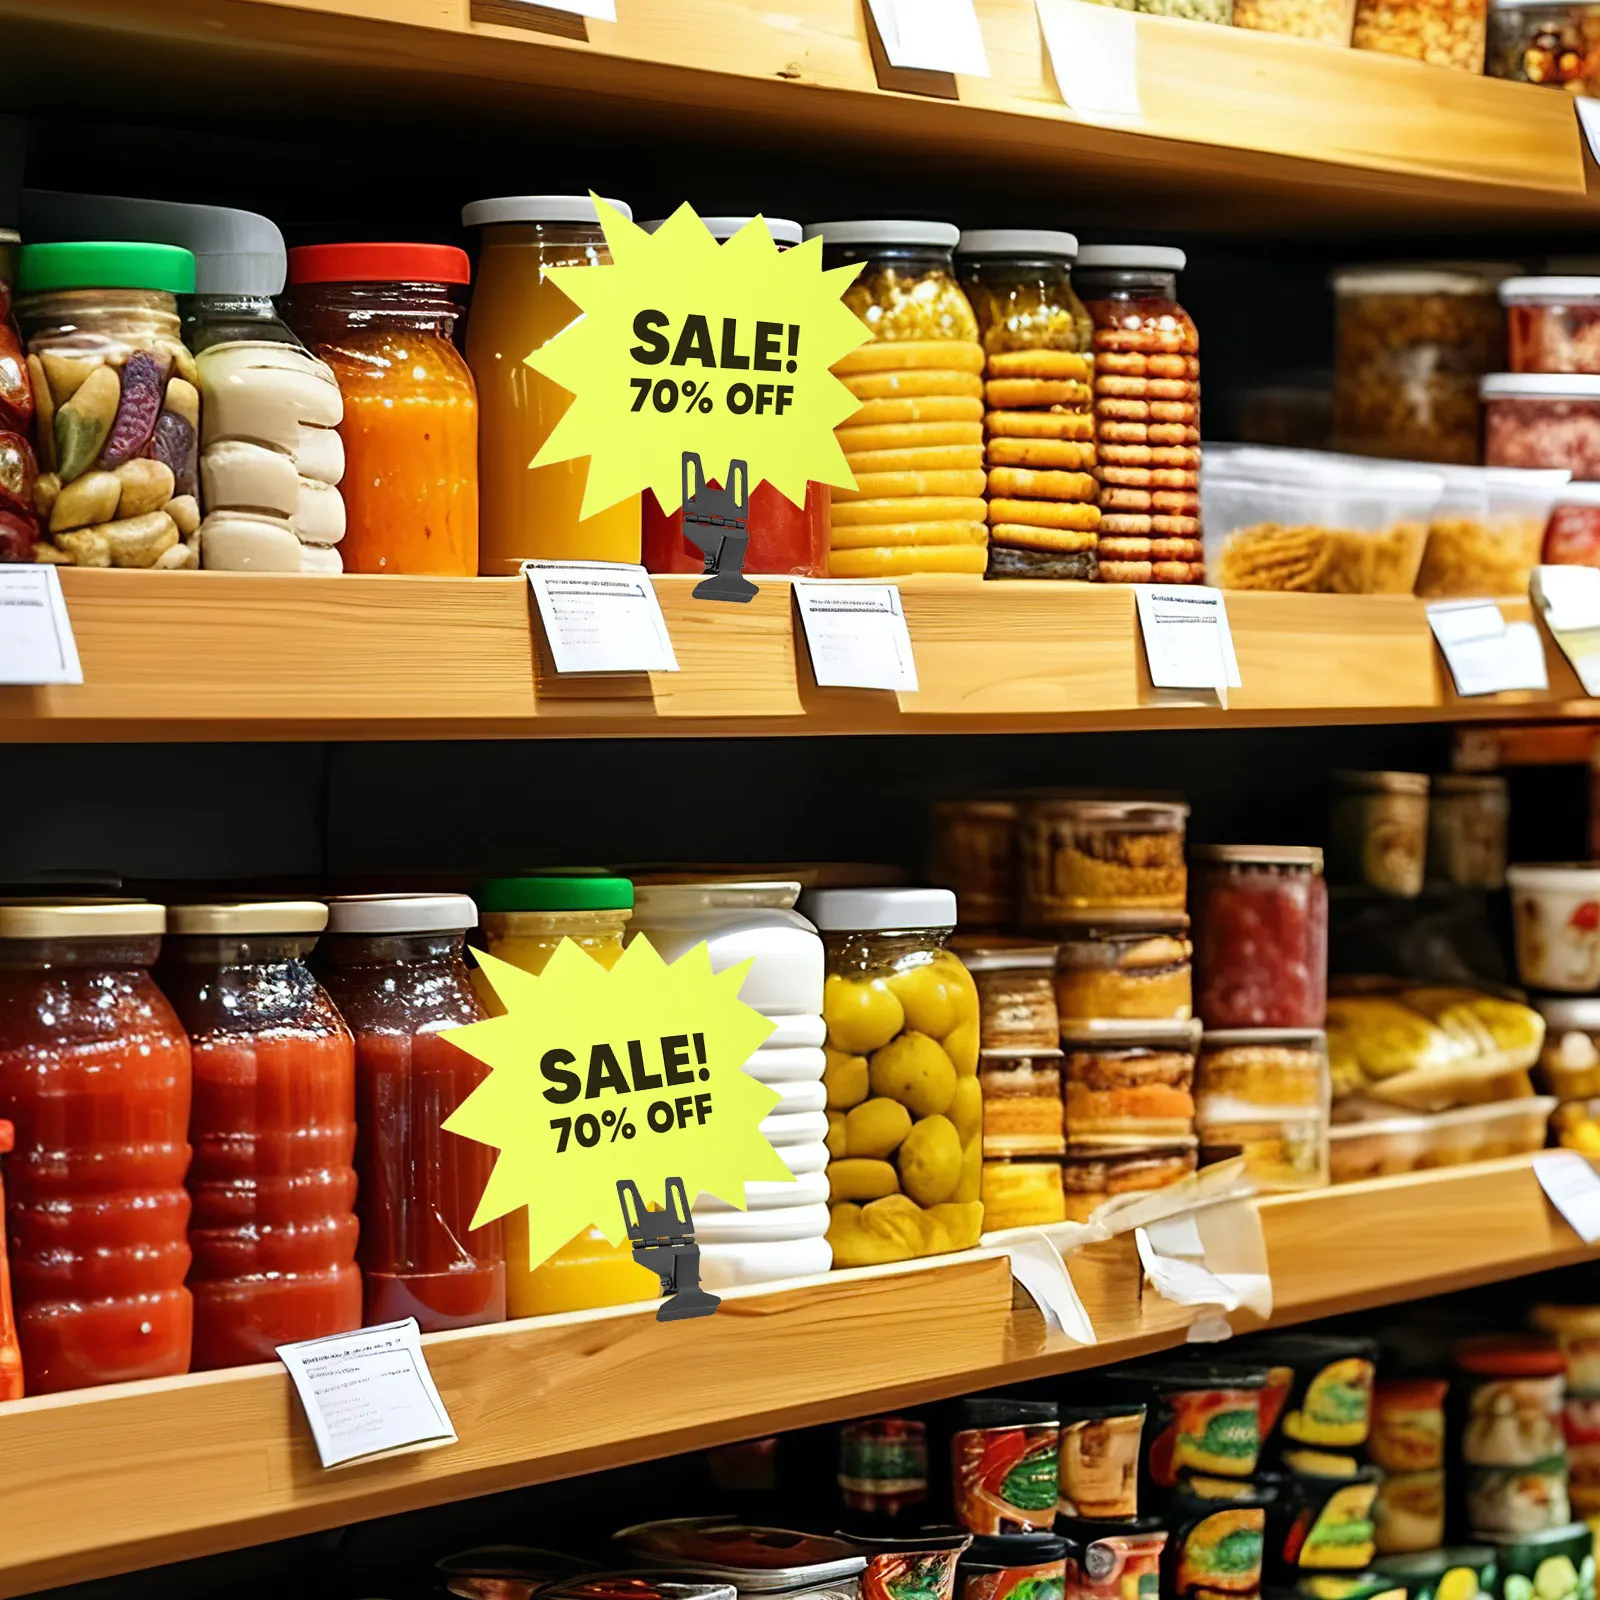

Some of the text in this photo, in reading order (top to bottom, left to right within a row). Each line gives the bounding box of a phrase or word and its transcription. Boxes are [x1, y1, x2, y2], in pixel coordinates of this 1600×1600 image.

[630, 310, 800, 373] SALE!
[631, 378, 793, 415] 70% OFF
[540, 1033, 709, 1104] SALE!
[550, 1093, 712, 1153] 70% OFF
